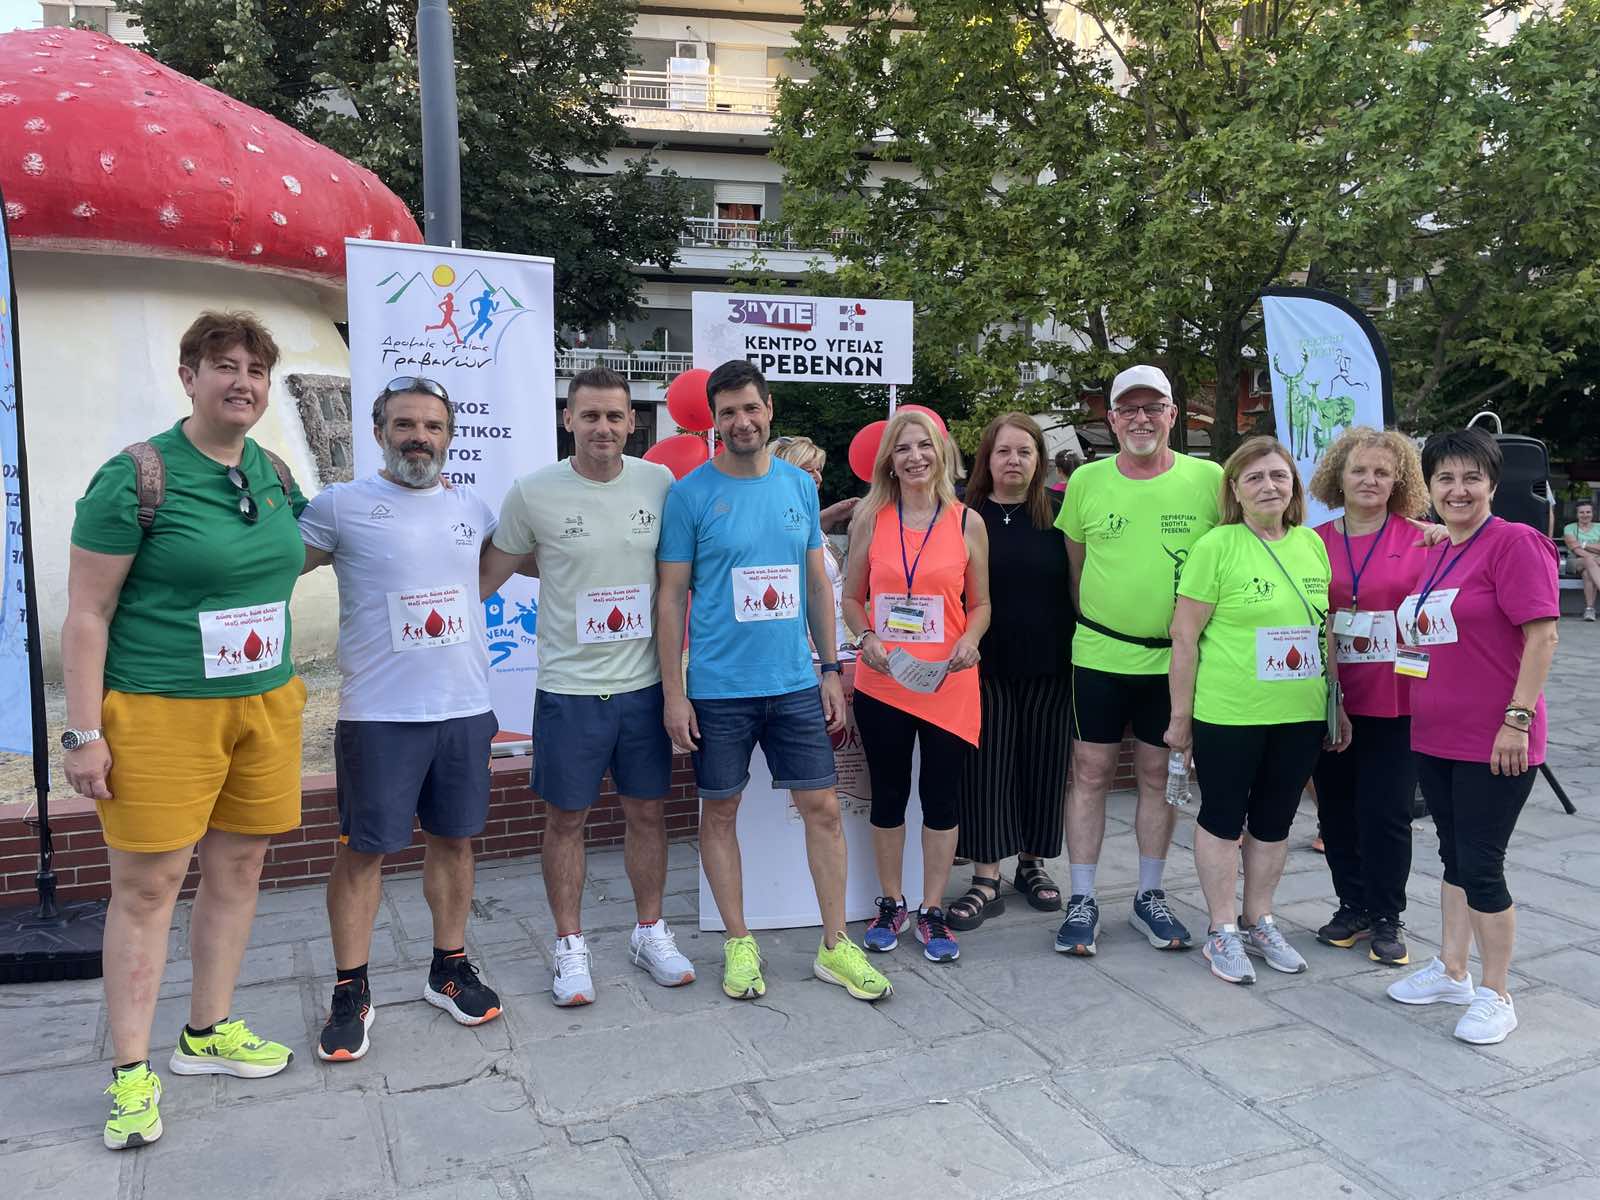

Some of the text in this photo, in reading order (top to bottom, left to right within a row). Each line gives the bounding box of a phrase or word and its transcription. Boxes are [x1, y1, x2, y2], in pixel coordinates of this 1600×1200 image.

[745, 335, 884, 354] ΚΕΝΤΡΟ ΥΓΕΙΑΣ
[382, 349, 492, 373] Γρεβενών
[454, 402, 490, 415] ΚΟΣ
[448, 449, 482, 461] ΓΟΣ
[486, 628, 514, 640] VENA
